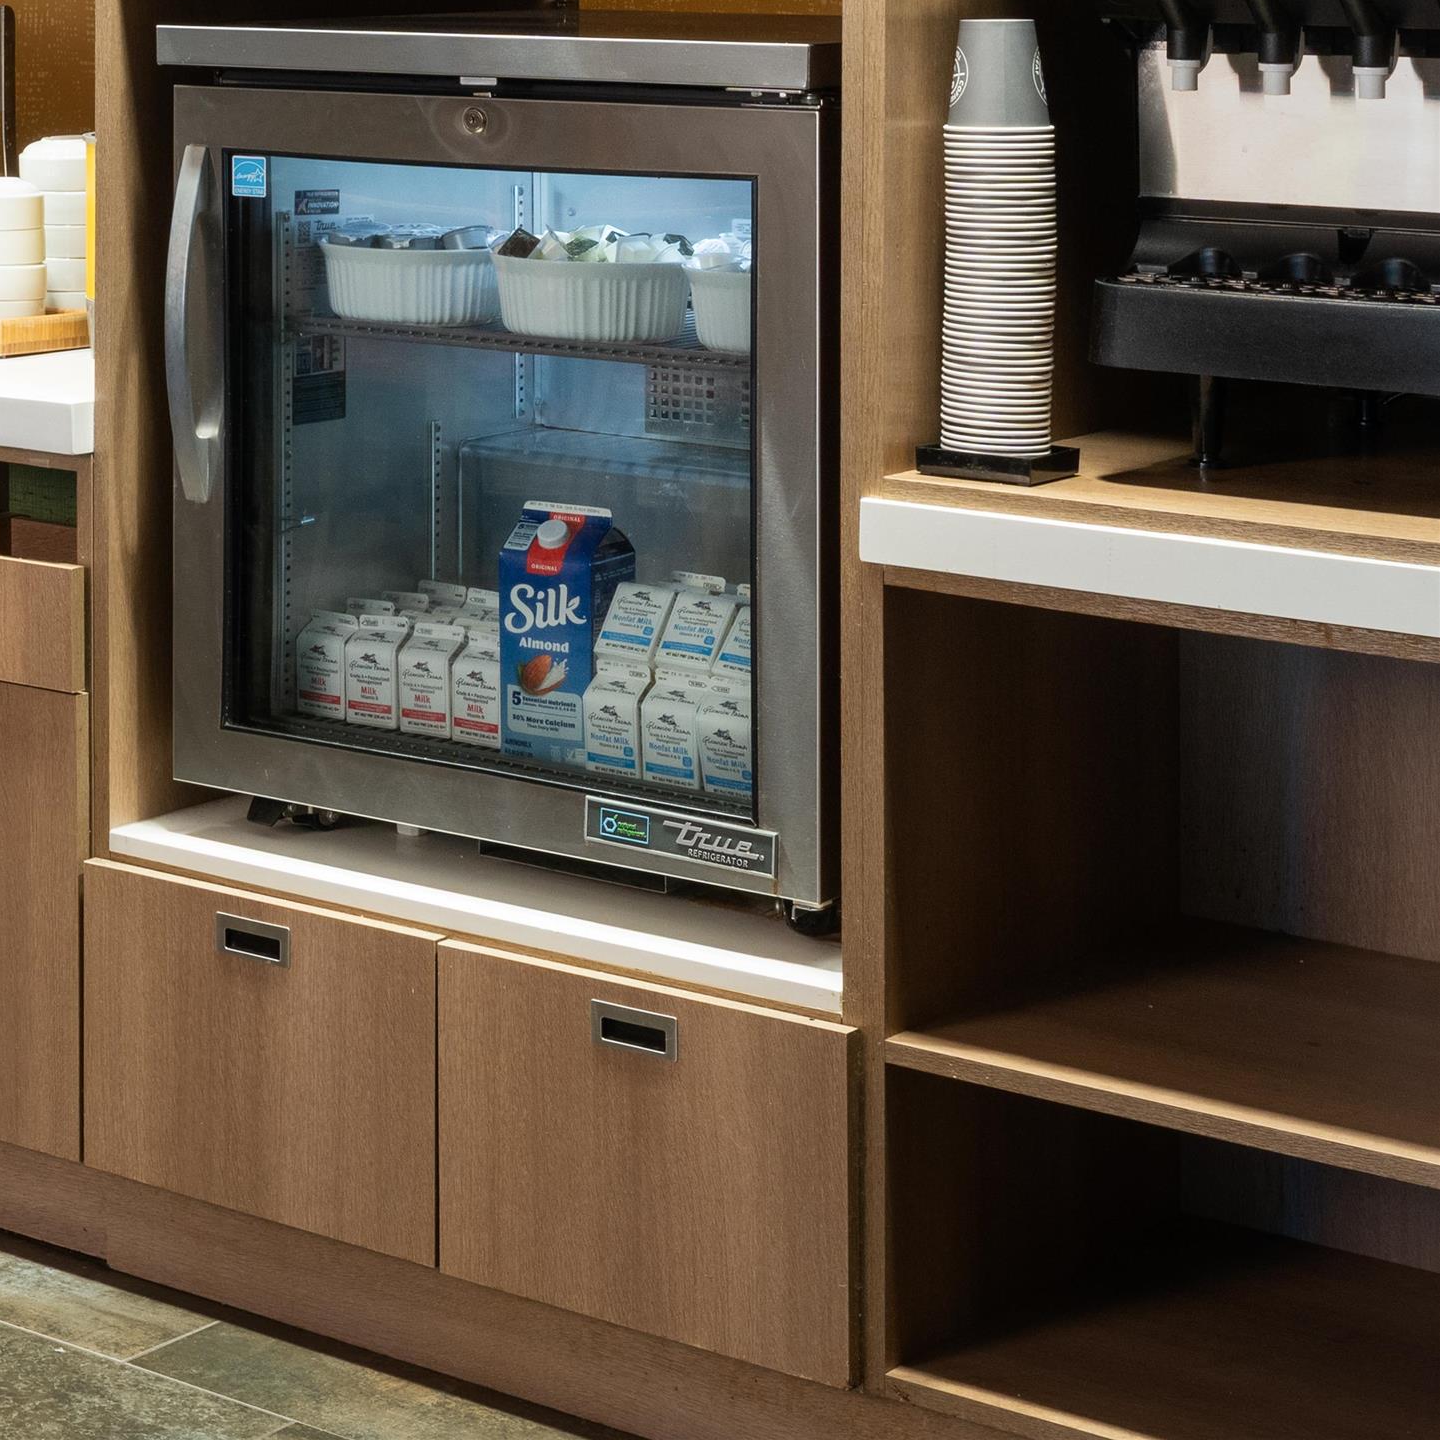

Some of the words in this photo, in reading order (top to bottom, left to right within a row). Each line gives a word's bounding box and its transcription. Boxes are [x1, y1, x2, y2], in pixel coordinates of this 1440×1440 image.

[307, 201, 339, 209] INNOVATION
[553, 514, 581, 523] ORIGINAL
[531, 563, 558, 572] ORIGINAL
[504, 583, 587, 634] Silk
[638, 617, 652, 625] Milk
[699, 627, 713, 635] Milk
[519, 637, 570, 653] Almond
[361, 686, 377, 696] Milk
[414, 694, 431, 704] Milk
[512, 691, 522, 706] 5
[522, 696, 547, 705] Essential
[548, 699, 576, 708] Nutrients
[467, 704, 484, 714] Milk
[526, 716, 544, 725] More
[545, 718, 576, 729] Calcium
[590, 732, 613, 743] Nonfat
[613, 736, 630, 745] Milk
[648, 742, 671, 753] Nonfat
[672, 745, 689, 755] Milk
[731, 759, 747, 769] Milk
[662, 820, 759, 860] true
[687, 848, 748, 868] REFRIGERATOR
